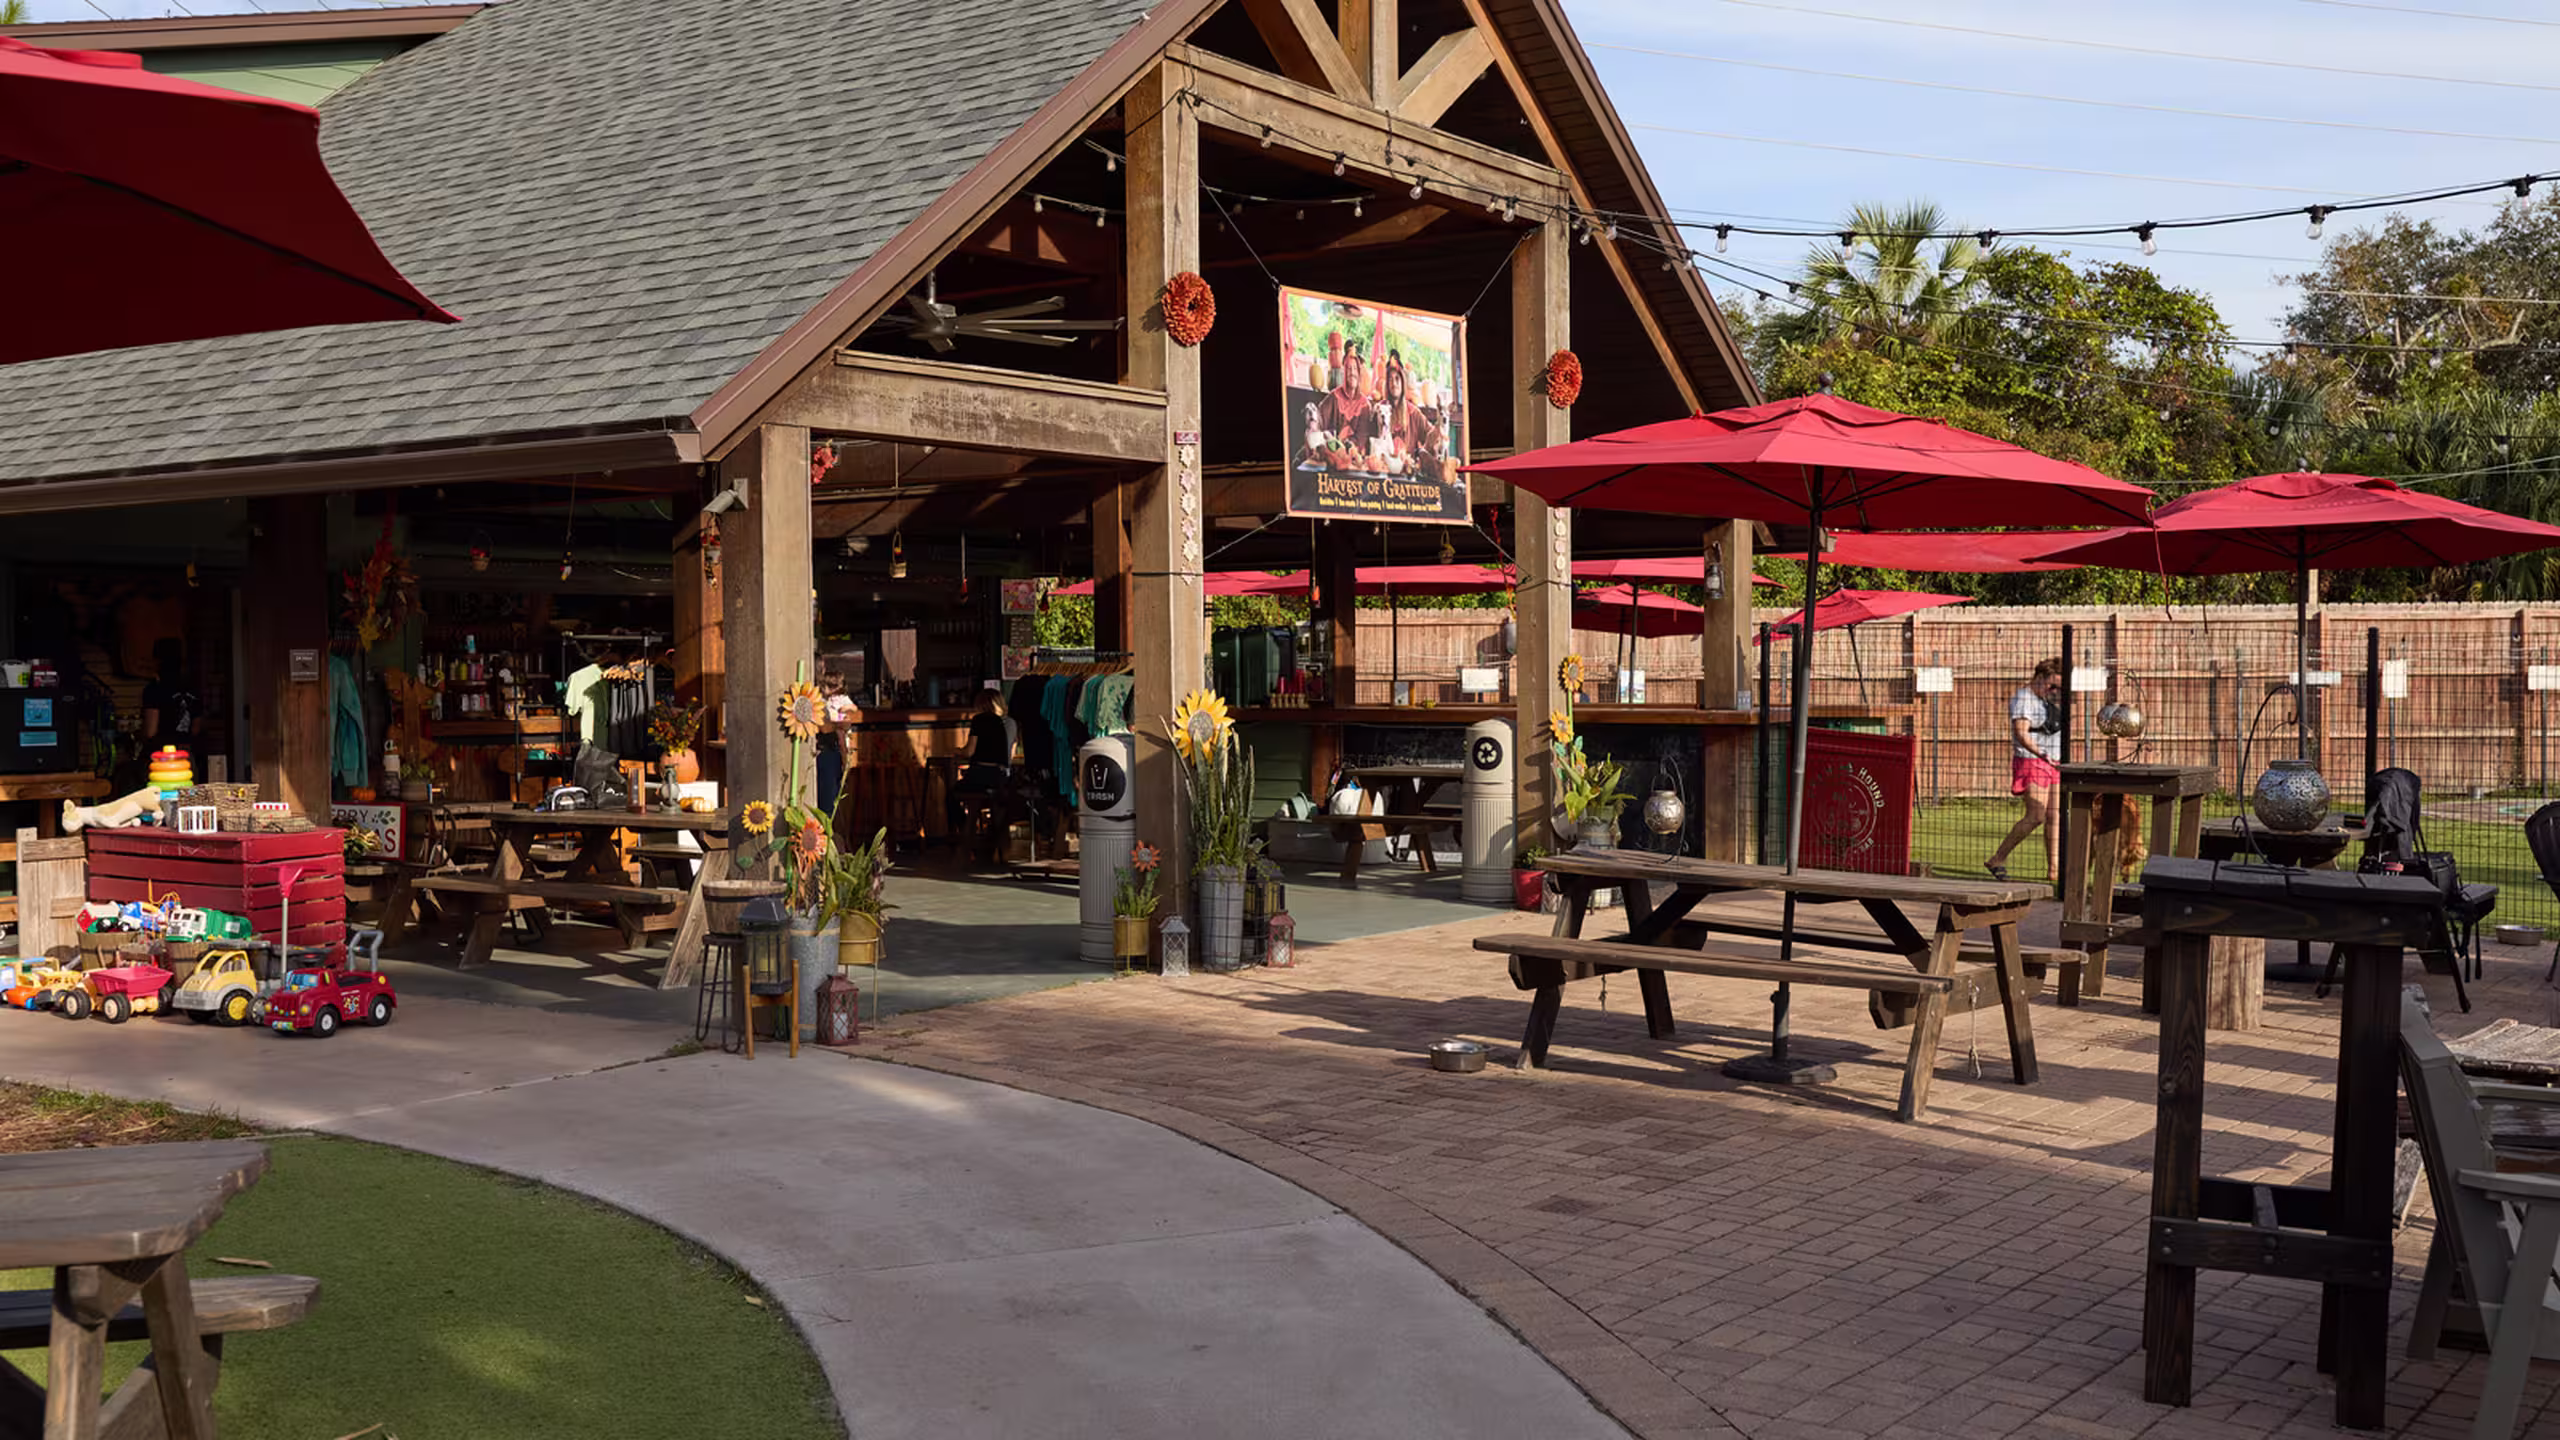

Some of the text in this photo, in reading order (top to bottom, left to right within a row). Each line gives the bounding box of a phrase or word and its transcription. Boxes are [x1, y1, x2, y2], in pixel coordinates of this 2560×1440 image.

[1318, 473, 1441, 500] HARVEST OF GRATITUDE
[1087, 792, 1115, 801] TRASH
[1858, 767, 1885, 808] HOUND
